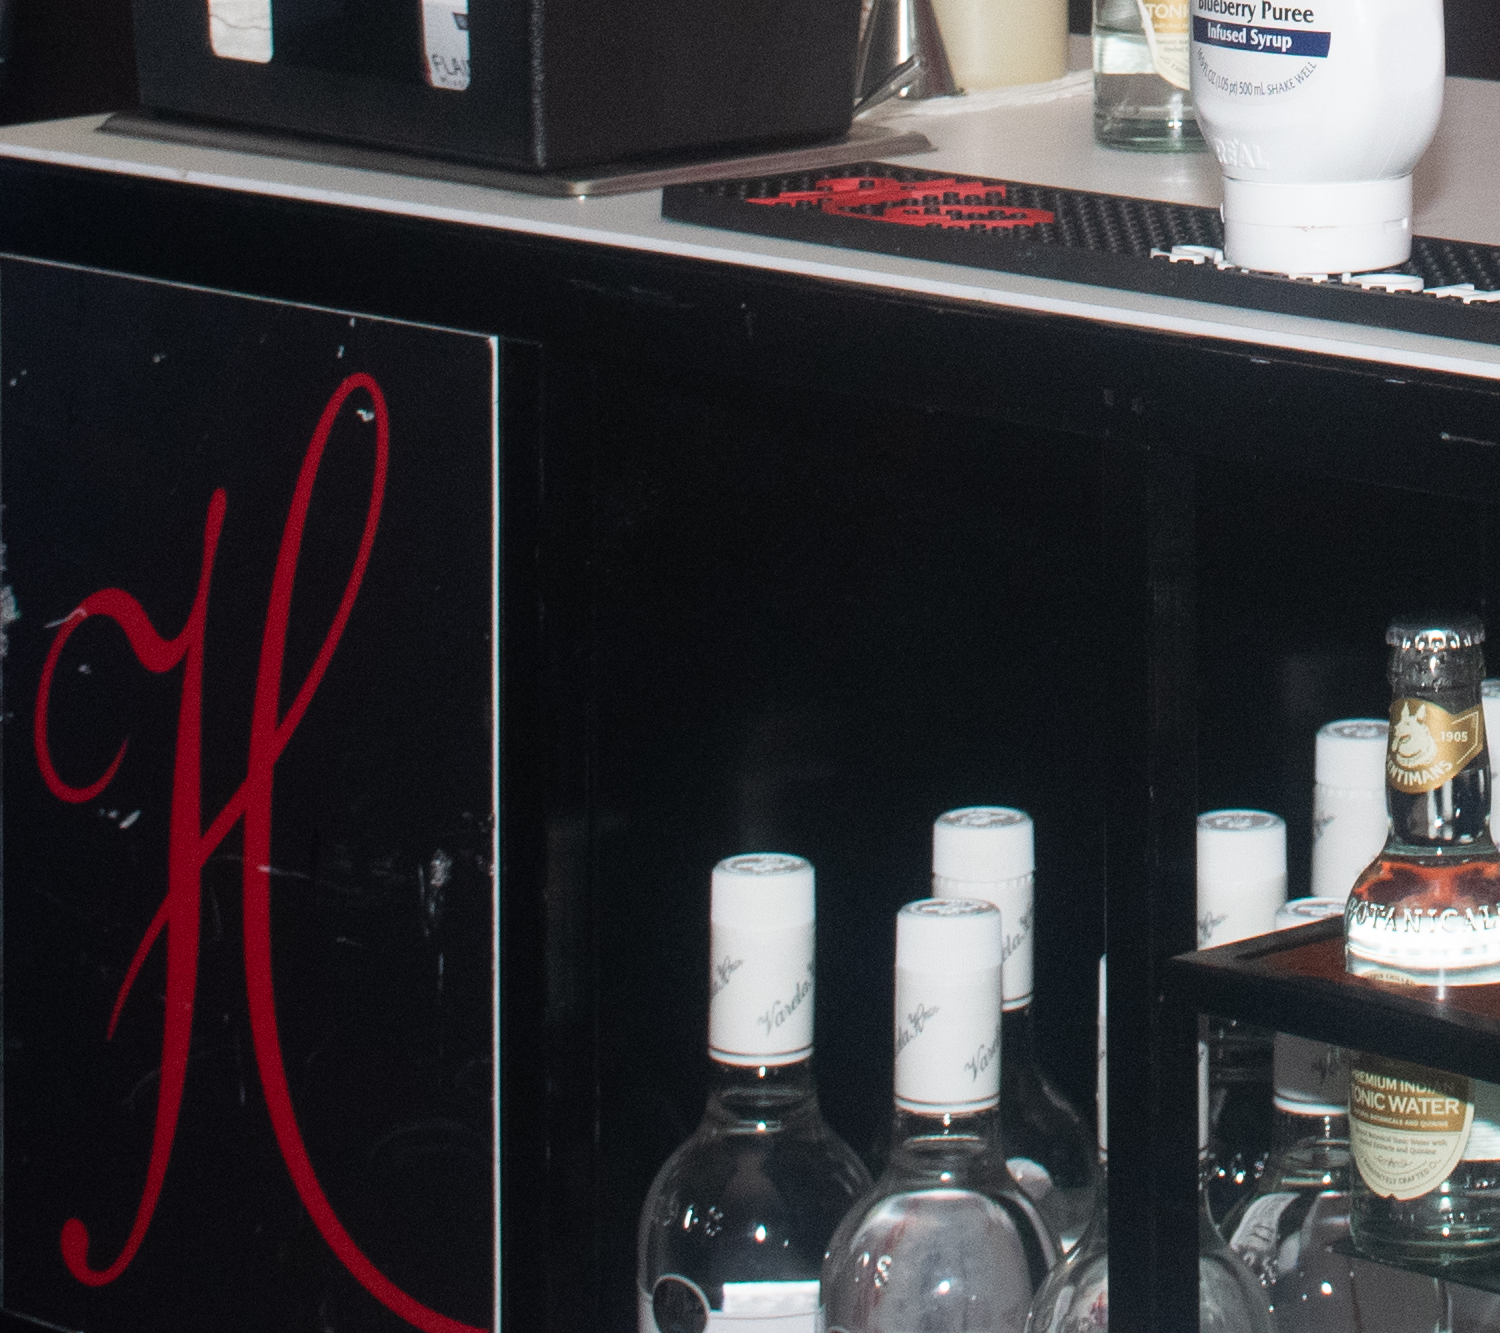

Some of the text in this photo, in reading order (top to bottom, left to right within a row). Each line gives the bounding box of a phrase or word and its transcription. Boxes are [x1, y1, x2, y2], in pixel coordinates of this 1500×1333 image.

[1261, 0, 1315, 23] Puree
[1207, 22, 1293, 52] Infused Syrup
[1239, 81, 1253, 96] 500
[1266, 78, 1295, 96] SHAKE
[1294, 61, 1317, 85] WELL
[1440, 730, 1468, 743] 1905
[1352, 1085, 1460, 1115] ONIC WATER
